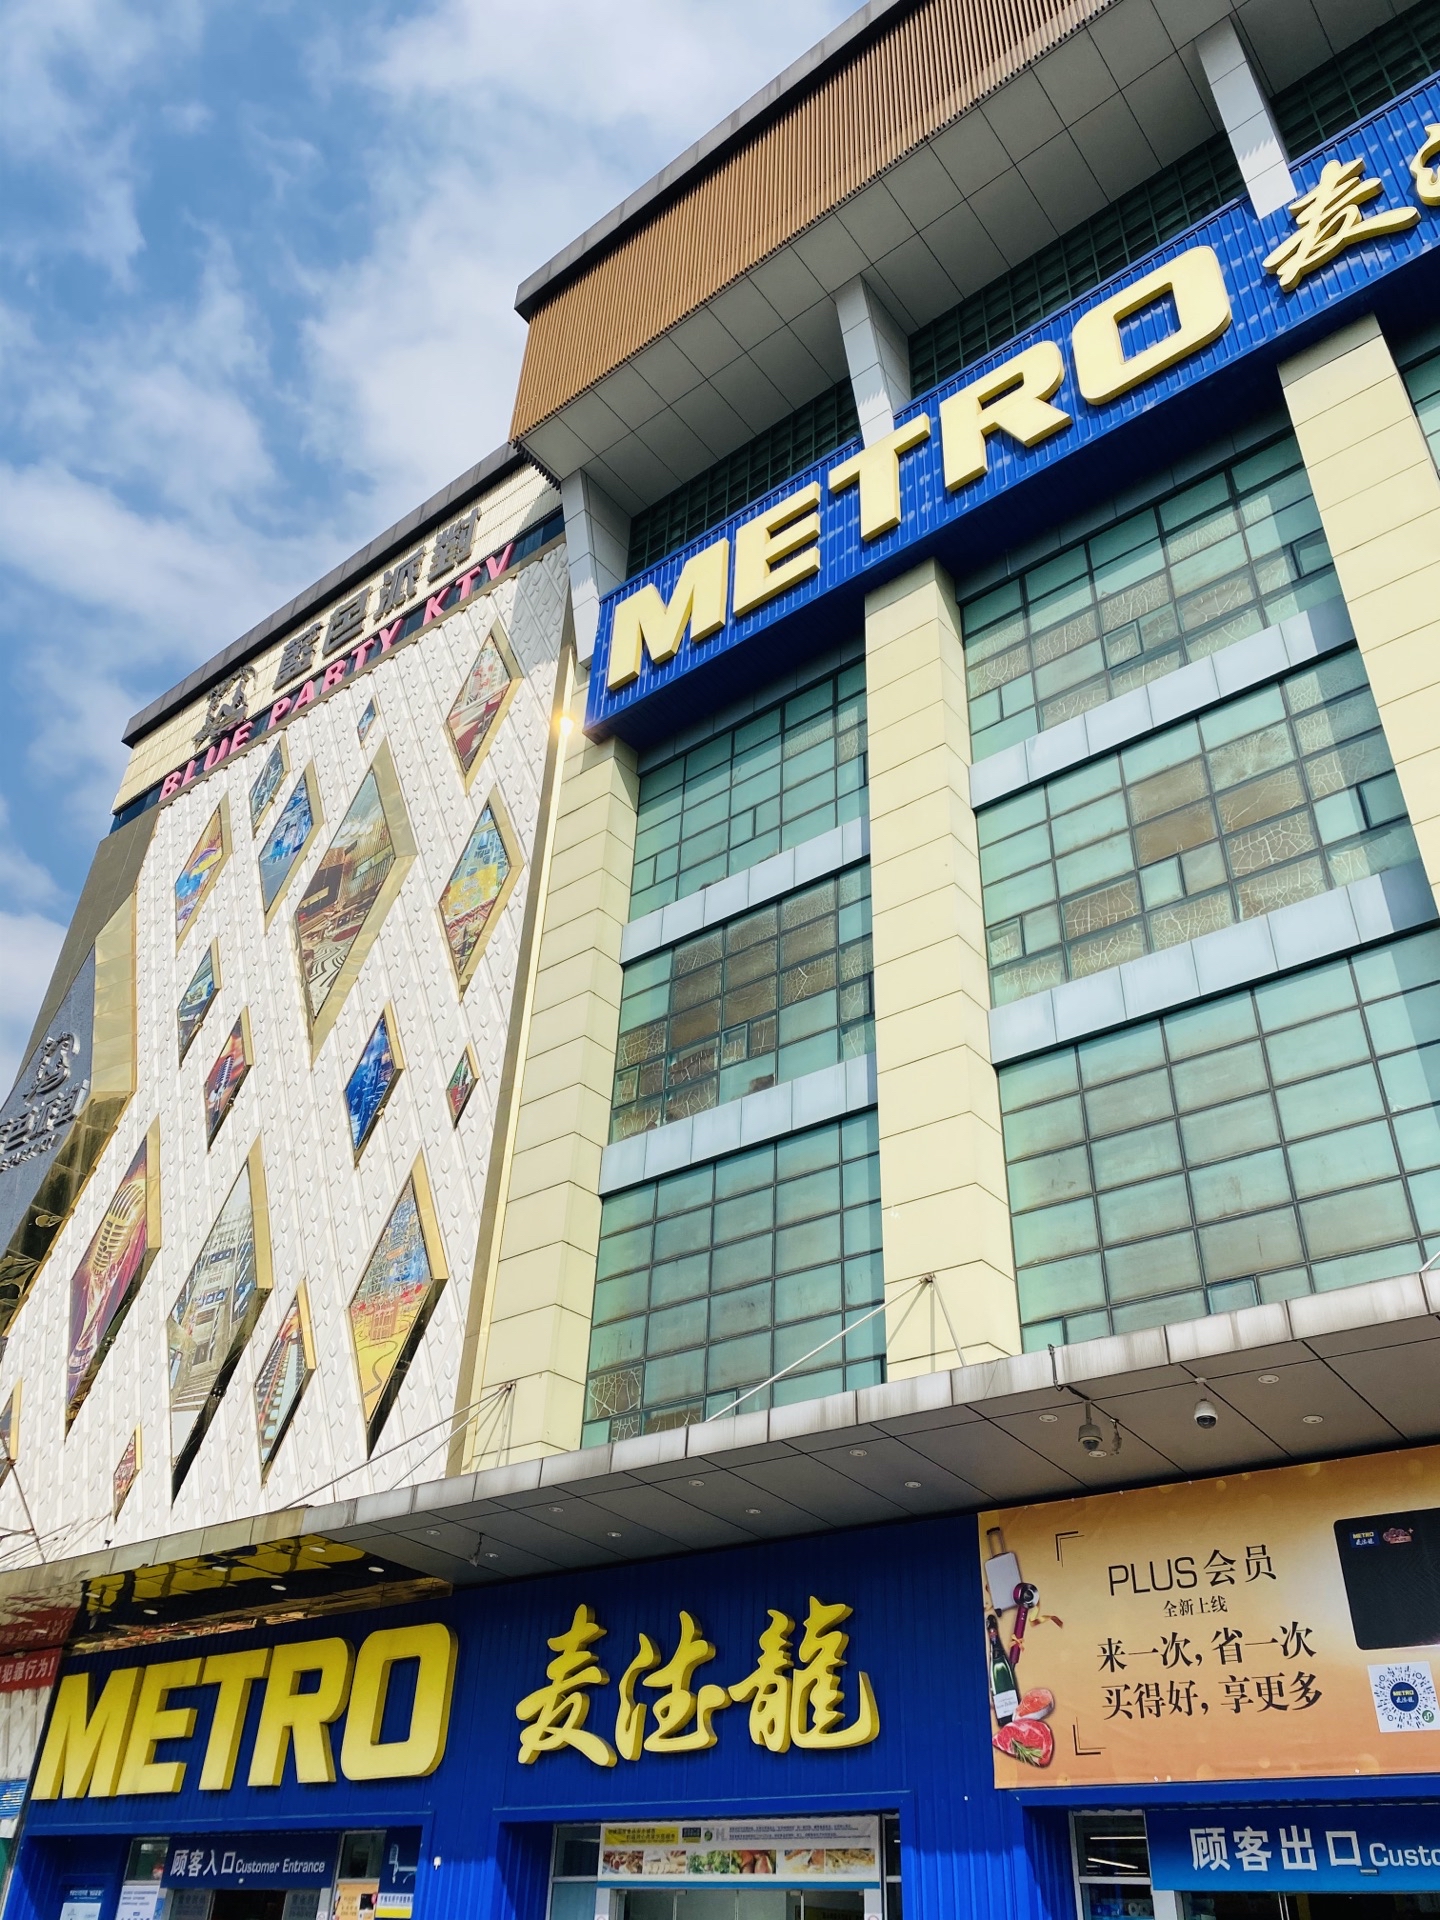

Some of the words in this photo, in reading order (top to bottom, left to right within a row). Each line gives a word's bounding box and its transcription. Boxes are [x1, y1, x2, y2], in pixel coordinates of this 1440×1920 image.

[1262, 123, 1440, 293] 麦
[607, 244, 1232, 691] METRO
[158, 721, 254, 802] BLUE
[268, 618, 404, 730] PARTY
[422, 542, 515, 627] KTV
[1163, 1594, 1228, 1618] 全新上线
[30, 1622, 458, 1800] METRO
[170, 1849, 236, 1877] 顾客入口
[236, 1859, 279, 1874] Customer
[282, 1858, 325, 1874] Entrance
[1189, 1825, 1362, 1872] 顾客出口
